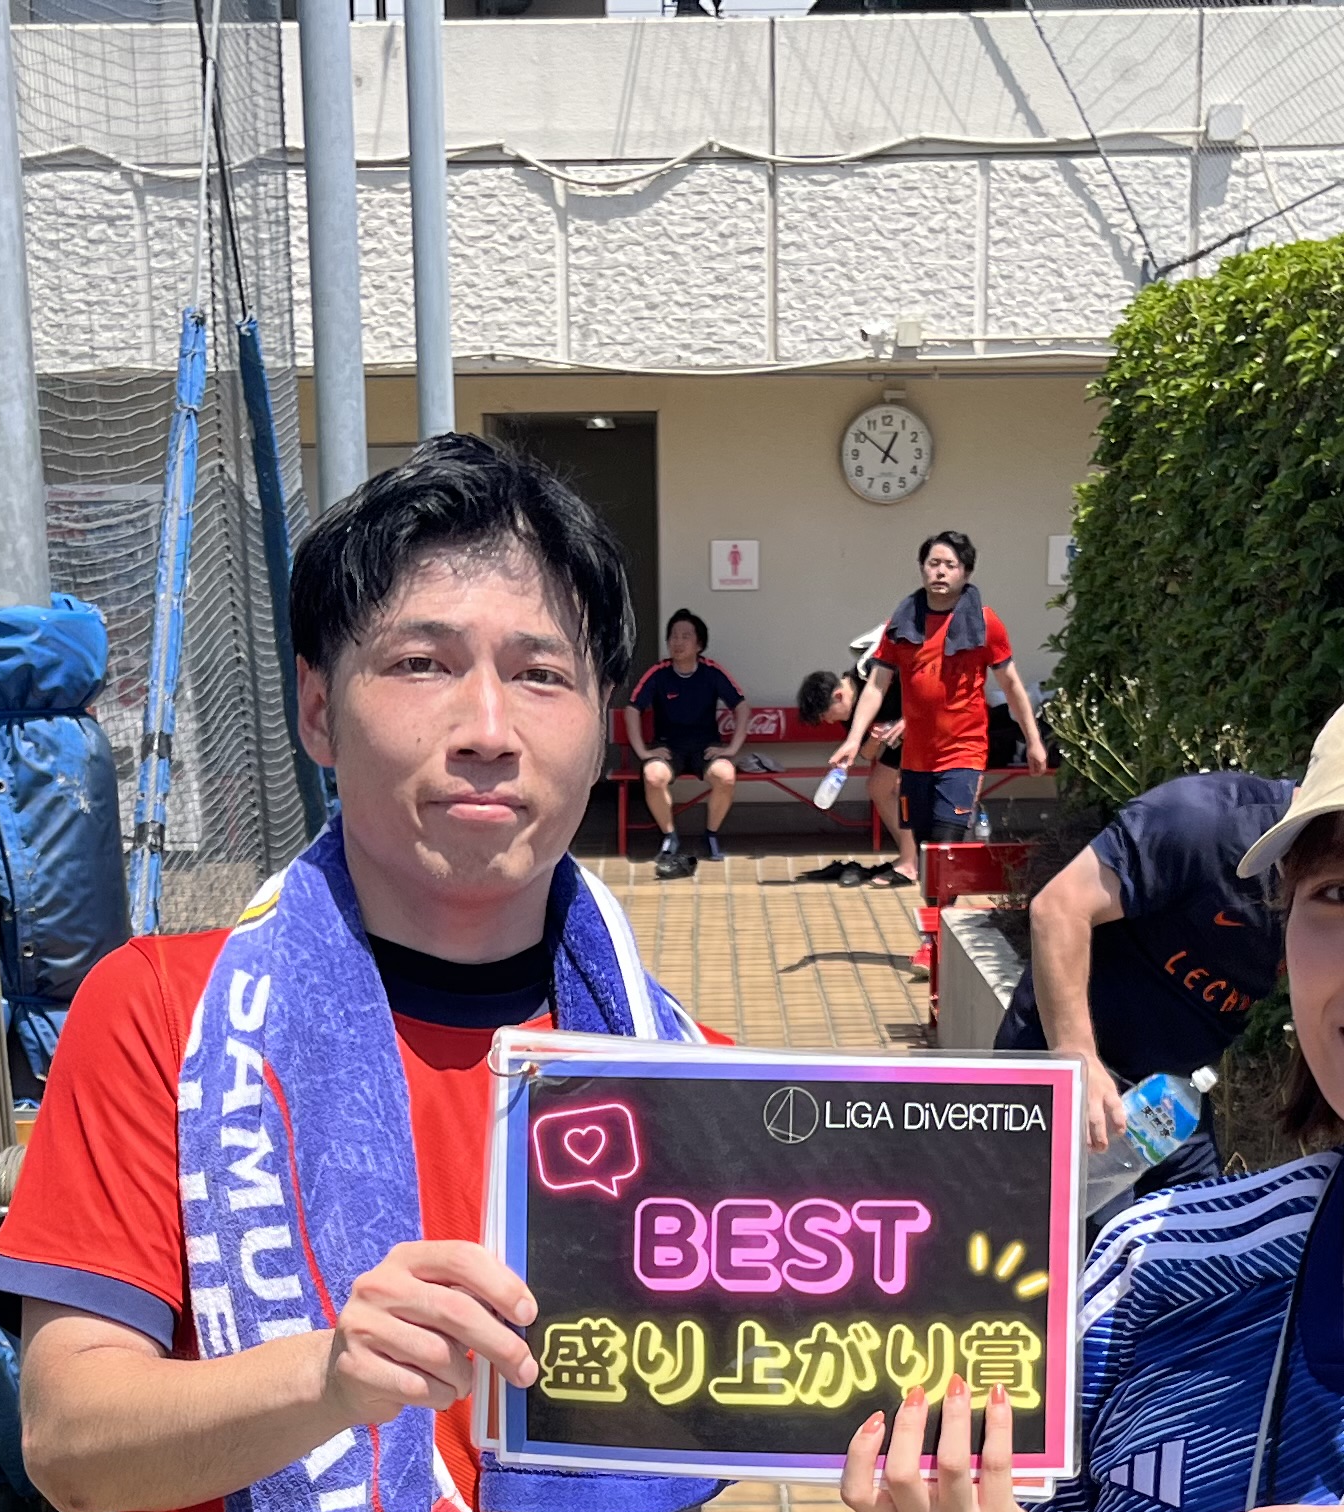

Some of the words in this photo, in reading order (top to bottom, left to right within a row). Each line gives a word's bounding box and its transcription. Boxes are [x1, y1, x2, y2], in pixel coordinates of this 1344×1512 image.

[867, 419, 877, 431] 11
[881, 414, 894, 427] 12
[901, 419, 906, 431] 1
[910, 431, 918, 443] 2
[851, 449, 860, 460] 9
[914, 448, 923, 460] 3
[855, 465, 864, 477] 8
[910, 465, 918, 476] 4
[867, 477, 875, 489] 7
[882, 481, 891, 494] 6
[897, 476, 907, 489] 5
[634, 1197, 931, 1295] BEST
[541, 1318, 1043, 1409] 盛り上がり賞
